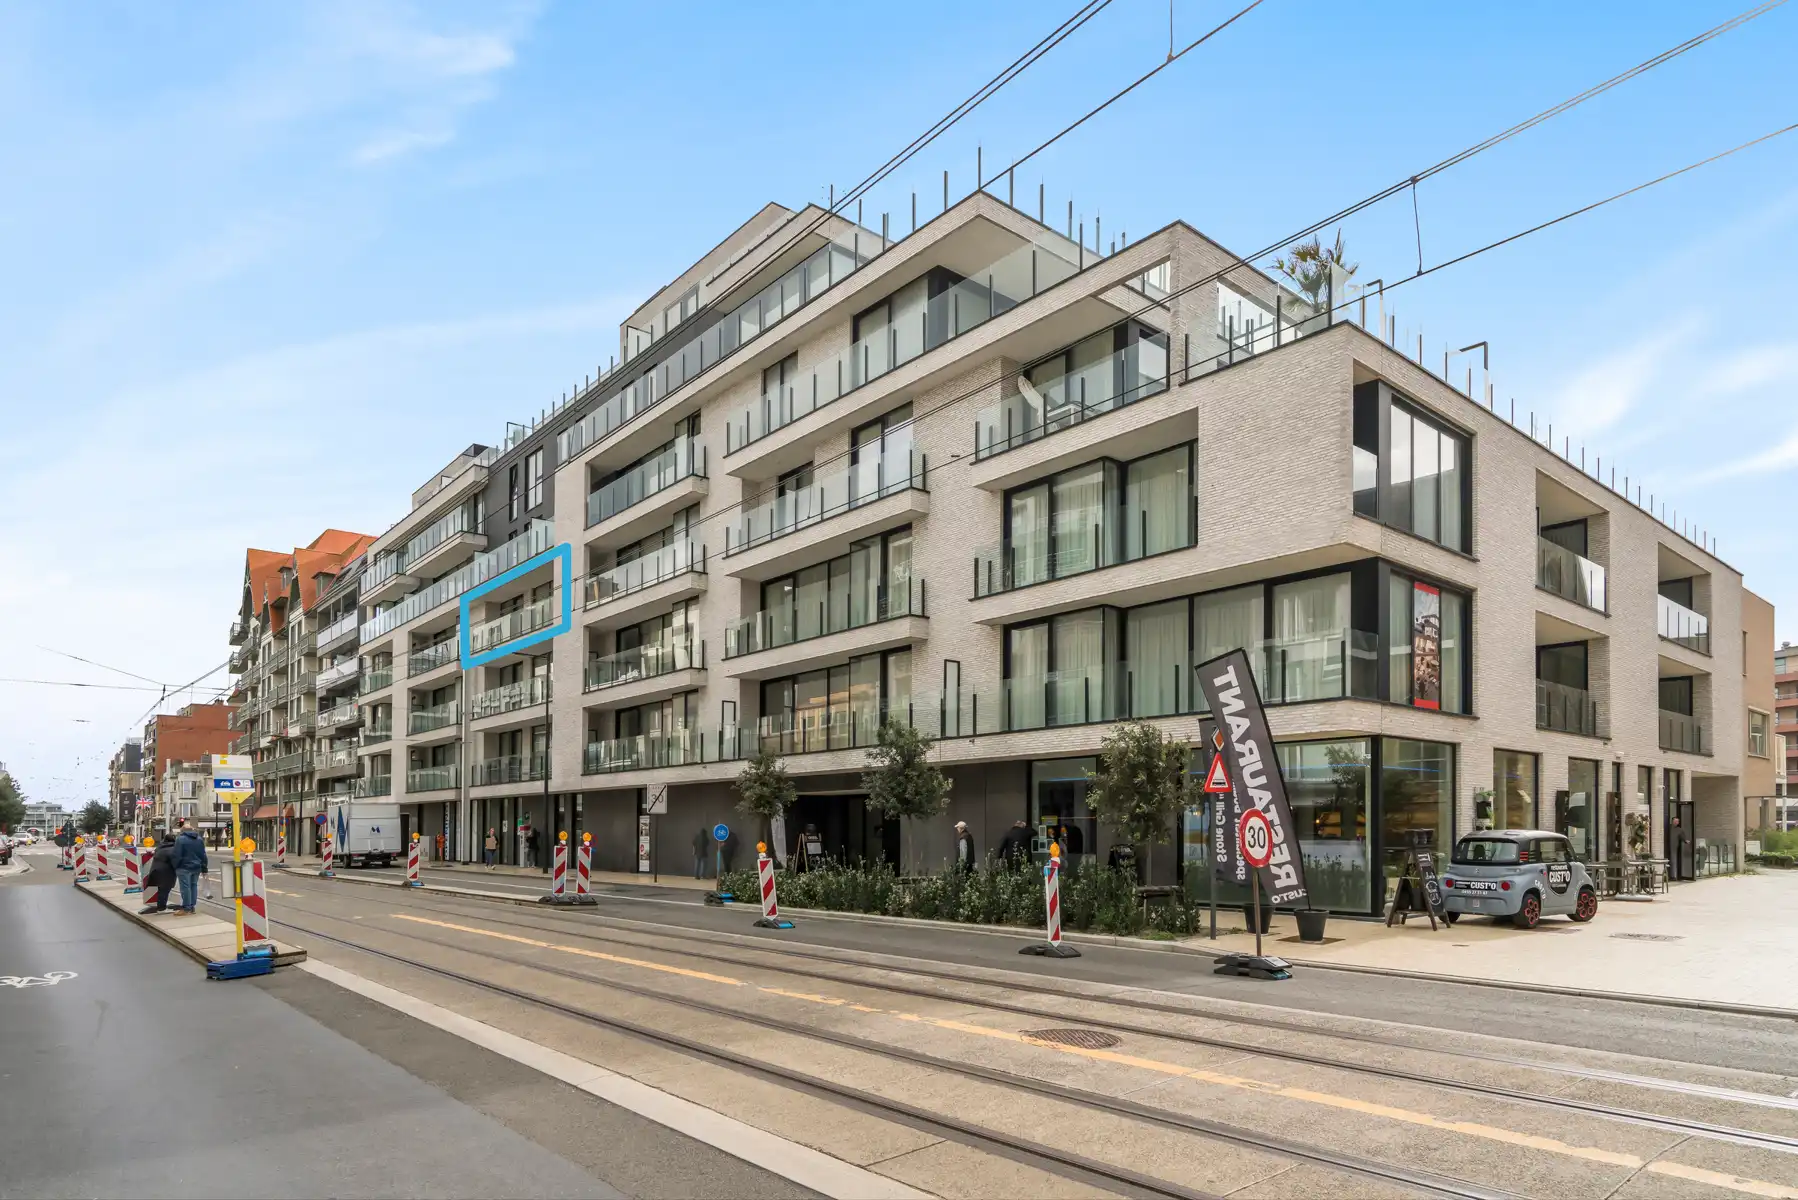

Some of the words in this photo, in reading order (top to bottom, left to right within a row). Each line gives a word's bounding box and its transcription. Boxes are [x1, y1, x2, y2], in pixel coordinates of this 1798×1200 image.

[1248, 825, 1266, 849] 30
[1549, 871, 1570, 883] CUST'O
[1470, 881, 1496, 890] CUST'O
